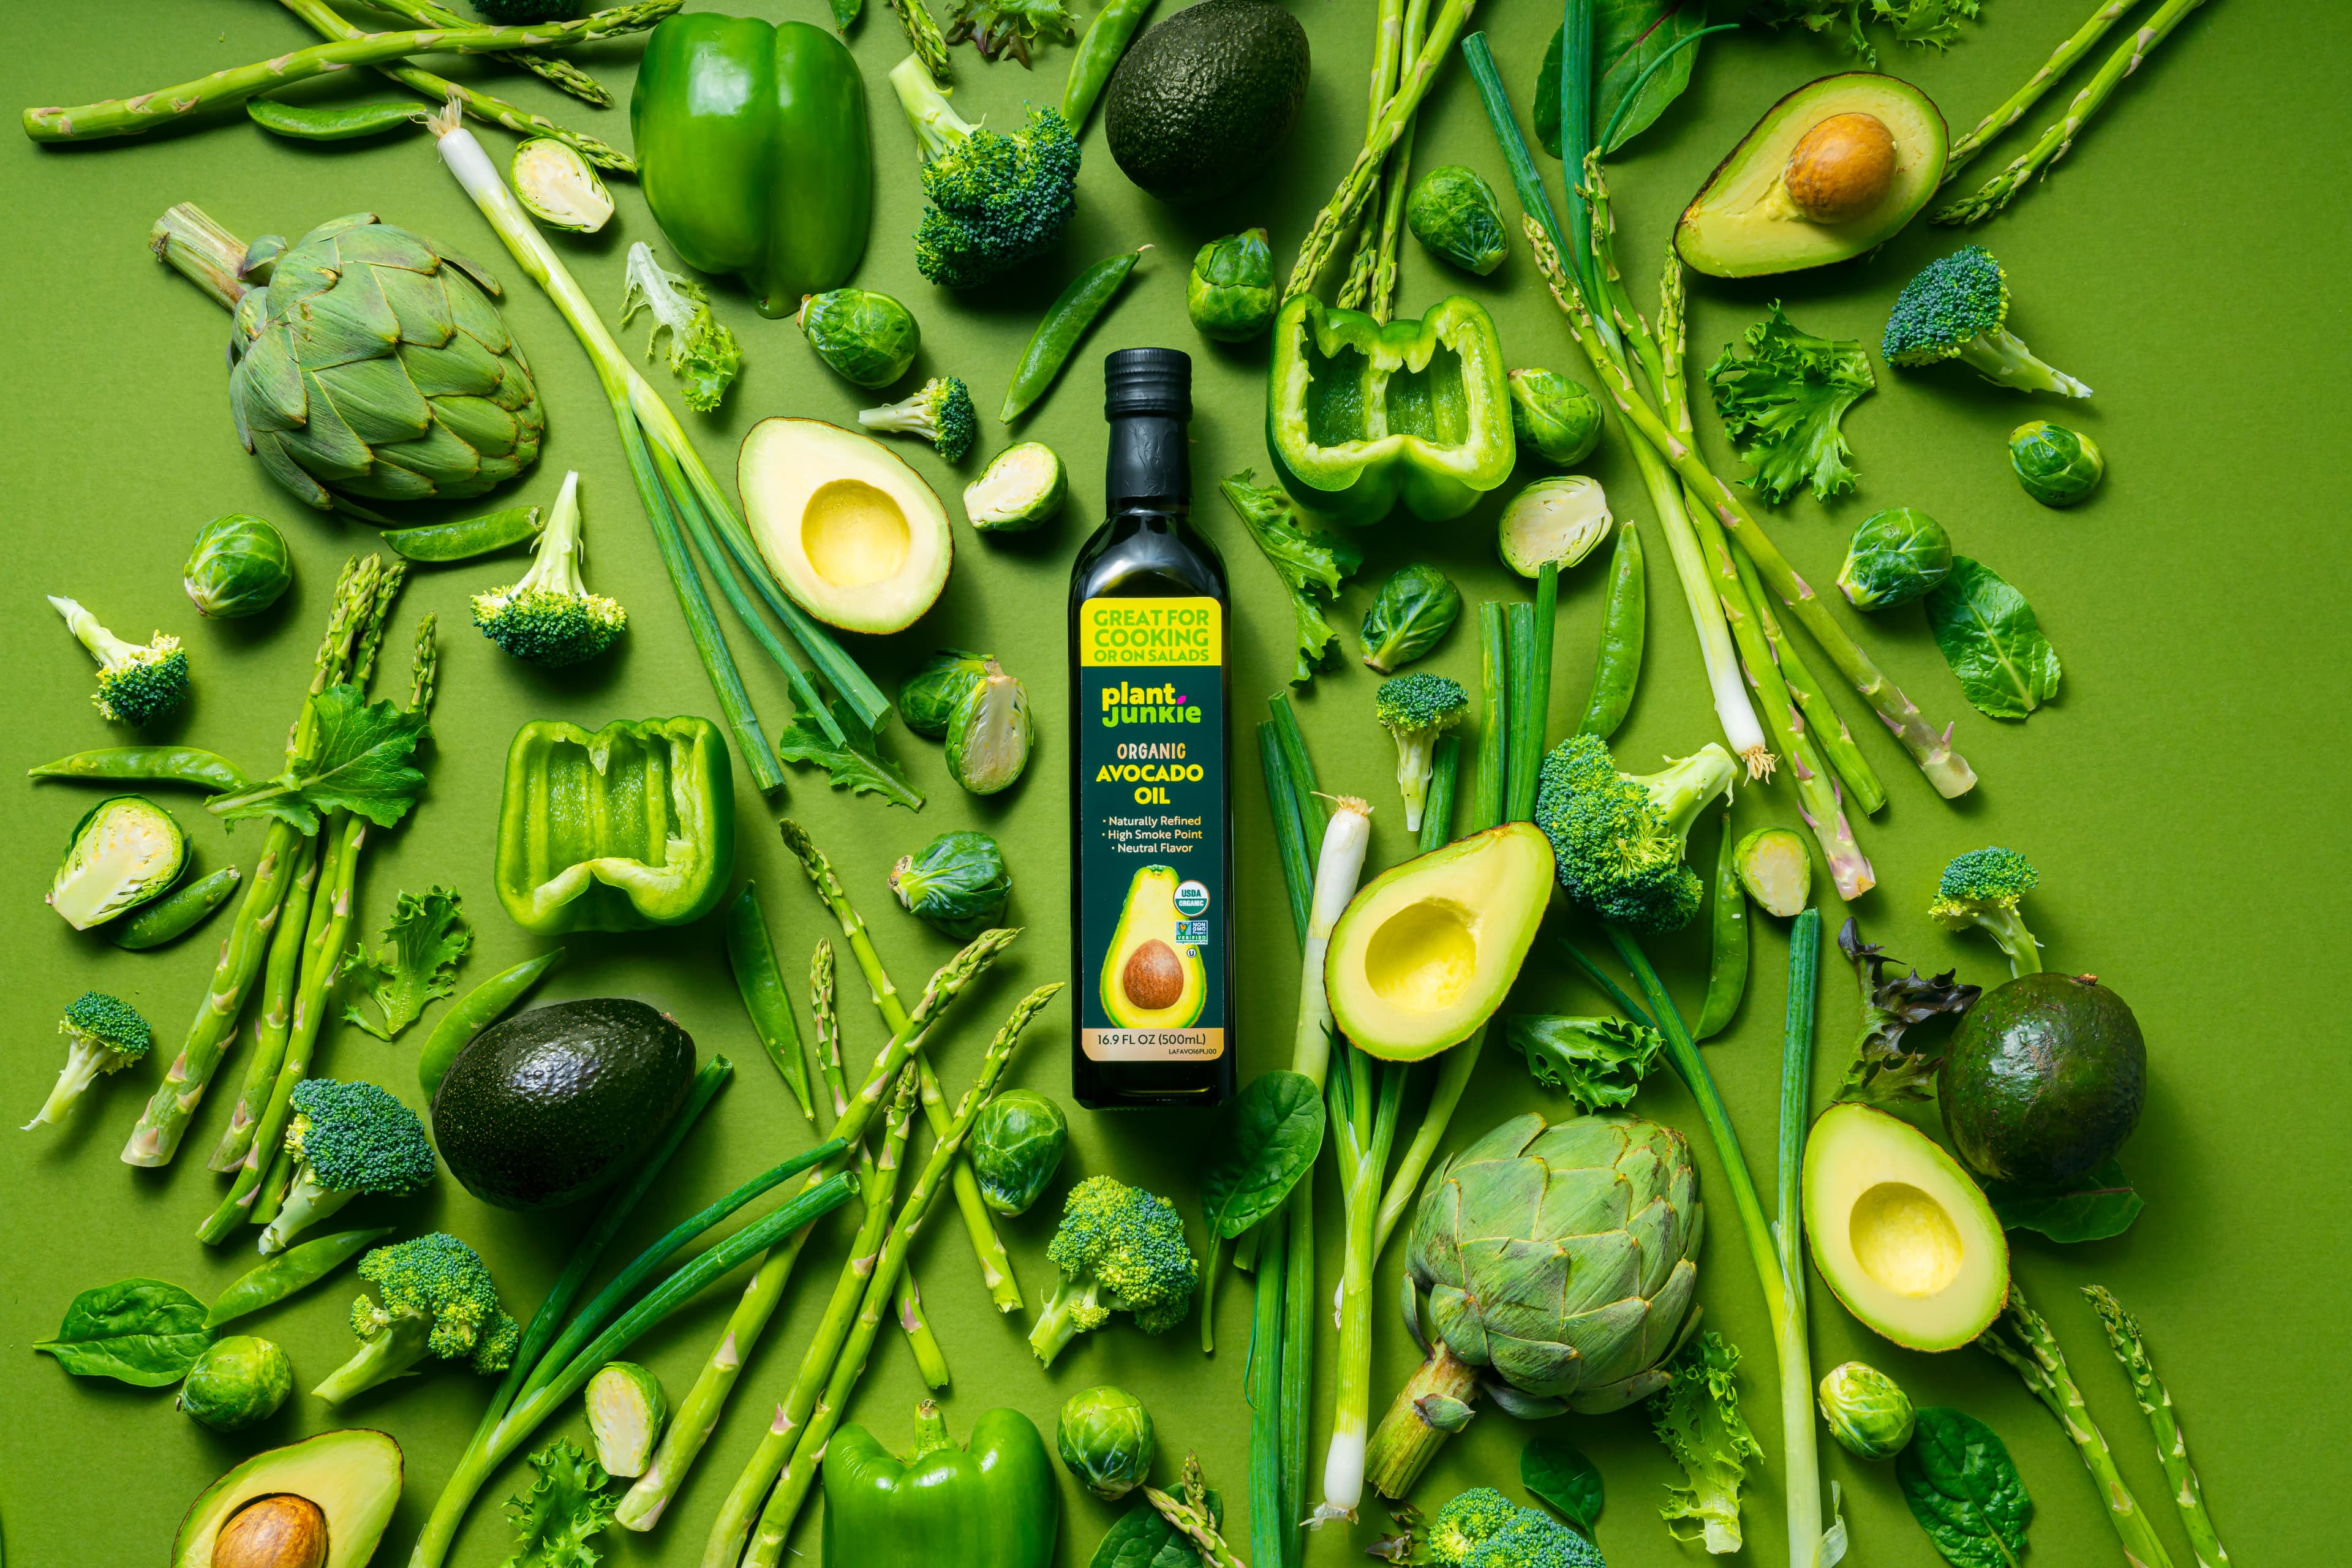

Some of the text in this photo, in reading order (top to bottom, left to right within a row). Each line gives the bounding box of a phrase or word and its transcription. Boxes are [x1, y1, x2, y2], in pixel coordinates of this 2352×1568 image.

[1093, 609, 1209, 627] GREAT FOR
[1095, 628, 1208, 647] COOKING
[1094, 649, 1209, 662] OR ON SALADS
[1102, 681, 1177, 711] plant
[1117, 743, 1186, 760] ORGANIC
[1096, 764, 1204, 782] AVOCADO
[1134, 786, 1170, 805] OIL
[1109, 816, 1201, 828] Naturally Refined
[1108, 829, 1202, 842] High Smoke Point
[1118, 843, 1193, 853] Neutral Flavor
[1098, 1034, 1206, 1045] 16.9 FL OZ (500mL)
